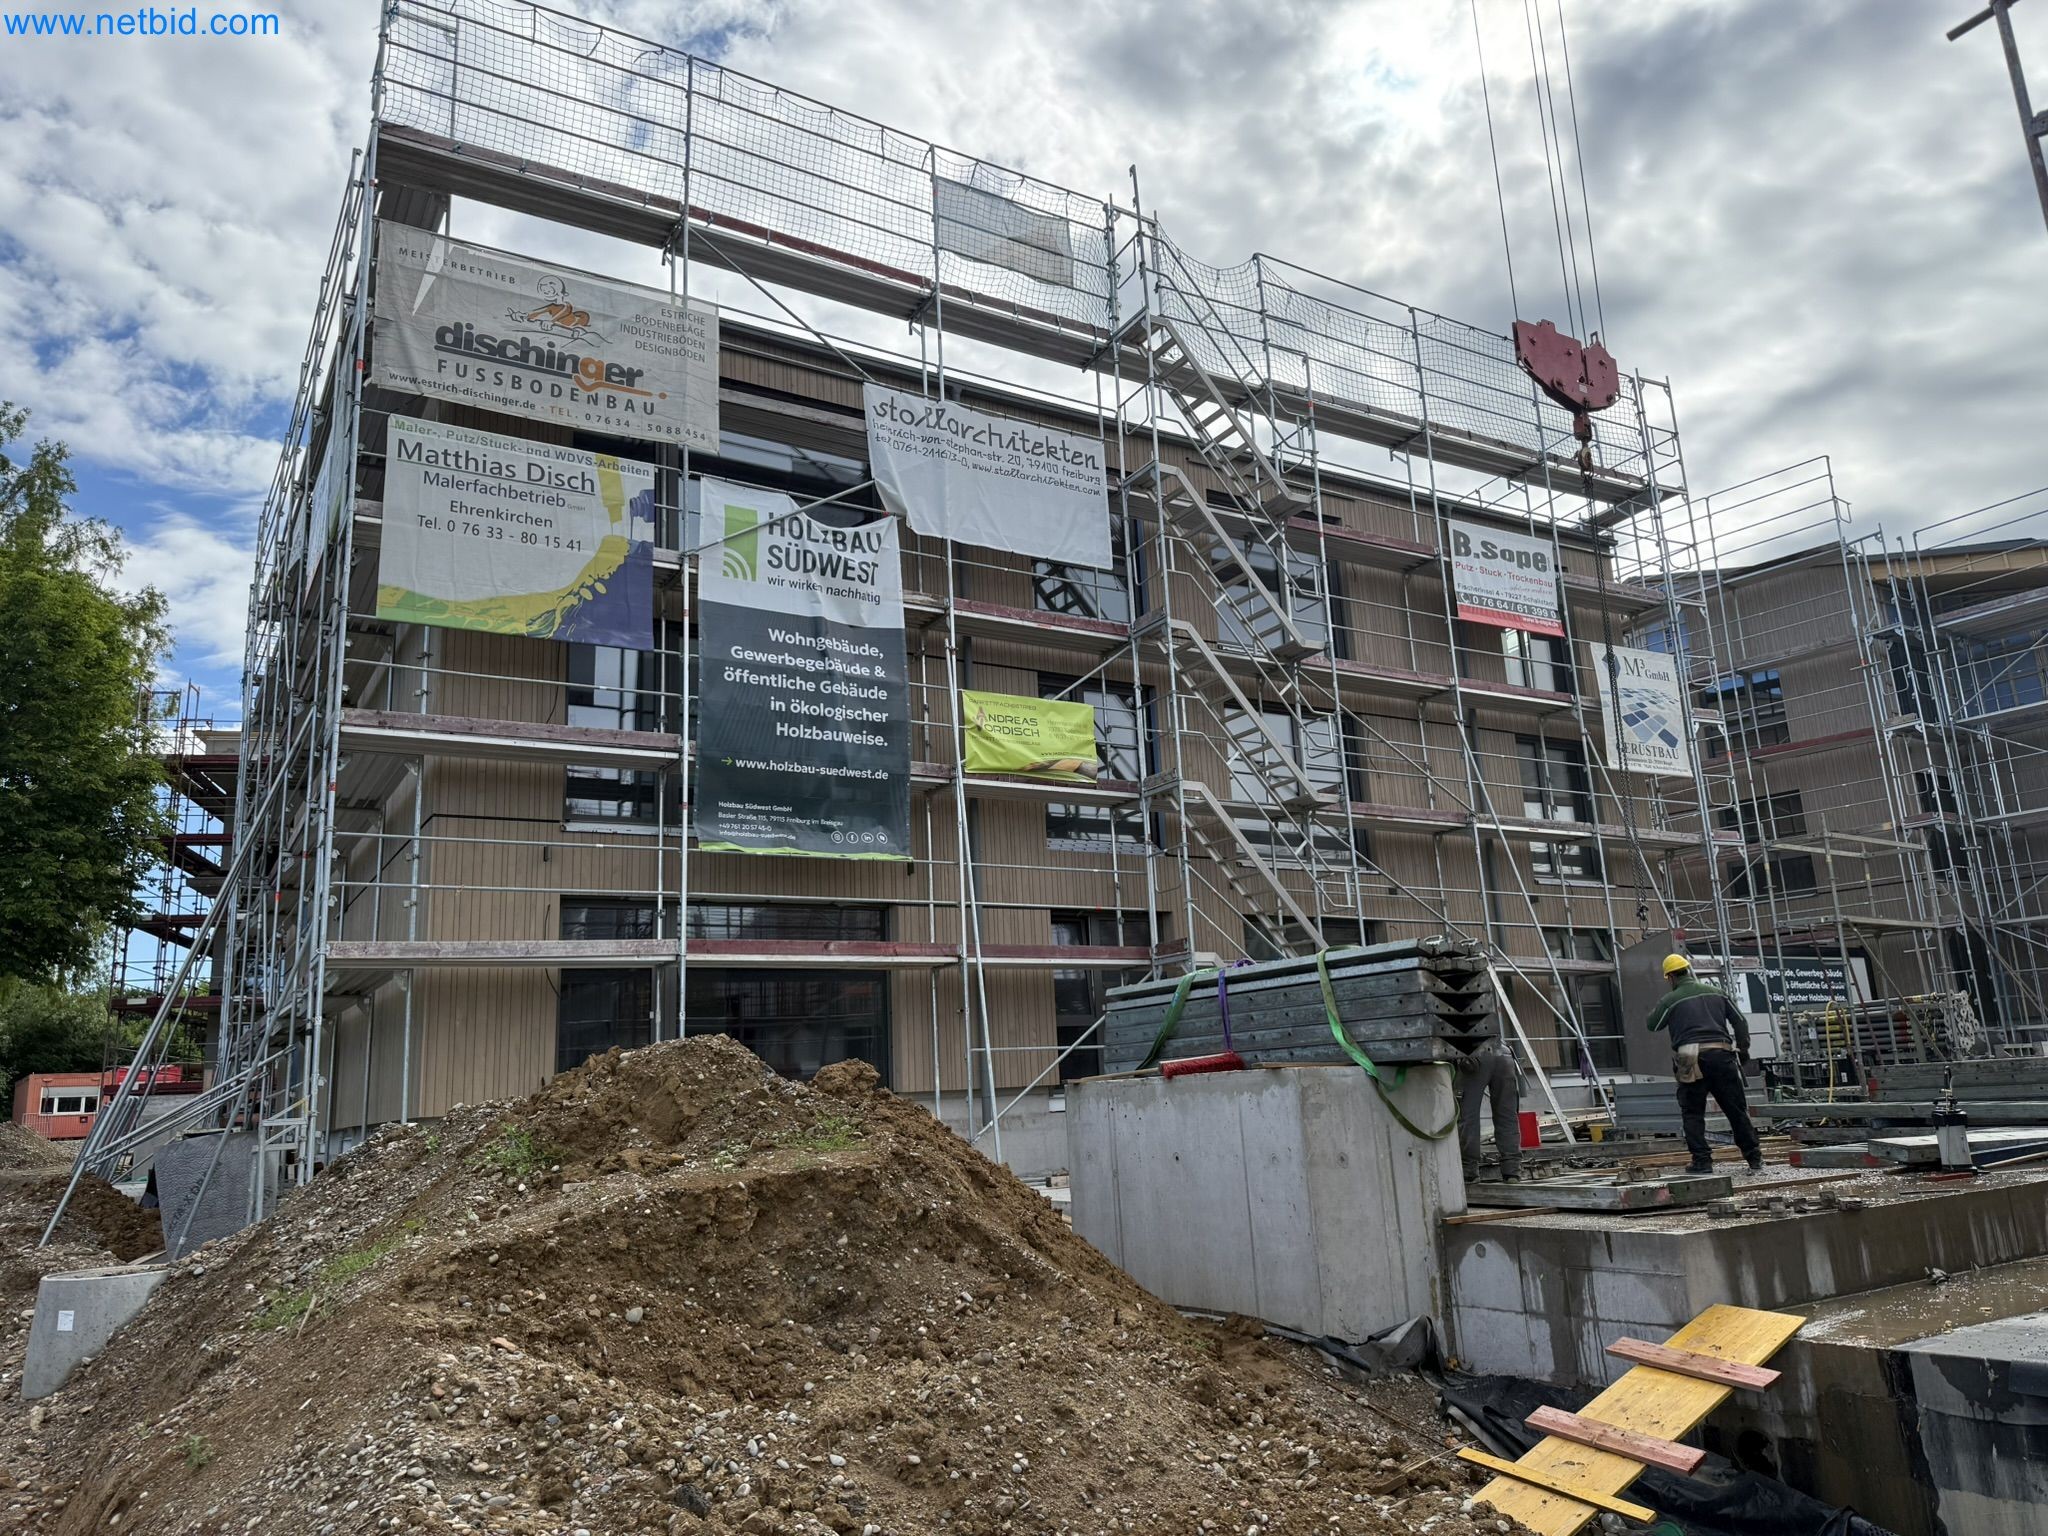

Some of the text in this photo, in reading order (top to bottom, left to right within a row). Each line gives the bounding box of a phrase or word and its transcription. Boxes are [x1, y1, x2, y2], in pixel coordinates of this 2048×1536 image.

[399, 247, 516, 285] MEISTERBETRIEB
[661, 308, 706, 326] ESTRICHE
[619, 323, 706, 350] INDUSTRIEBÖDEN
[635, 340, 706, 363] DESIGNBÖDEN
[434, 321, 645, 391] dischinger
[388, 372, 537, 411] www.estrich-dischinger.de
[550, 405, 578, 419] TEL.
[585, 413, 630, 428] 07634
[437, 358, 656, 416] FUSSBODENBAU
[872, 396, 1100, 471] stollarchitekten
[397, 438, 595, 493] Matthias Disch
[446, 429, 522, 452] Putz/Stuck-
[526, 446, 551, 459] und
[555, 450, 650, 477] WDVS-Arbeiten
[423, 470, 566, 509] Malerfachbetrieb
[1062, 465, 1101, 486] freiburg
[449, 500, 553, 528] Ehrenkirchen
[417, 514, 442, 531] Tel.
[446, 519, 456, 533] 0
[462, 521, 480, 537] 76
[486, 525, 503, 540] 33
[520, 531, 538, 545] 80
[545, 535, 561, 549] 15
[566, 538, 583, 552] 41
[767, 542, 879, 586] SÜDWEST
[1452, 528, 1548, 573] B.Sope
[767, 575, 785, 587] wir
[1455, 561, 1474, 572] Putz
[1479, 565, 1503, 578] Stuck
[1482, 597, 1494, 607] 76
[1497, 600, 1509, 610] 64
[1517, 604, 1528, 613] 61
[768, 627, 884, 660] Wohngebäude,
[730, 645, 887, 678] Gewerbegebäude &
[1645, 668, 1670, 682] GmbH
[723, 666, 888, 700] öffentliche Gebäude
[770, 696, 889, 723] in ökologischer
[776, 722, 888, 747] Holzbauweise.
[735, 757, 889, 780] www.holzbau-suedwest.de
[718, 801, 744, 810] Holzbau
